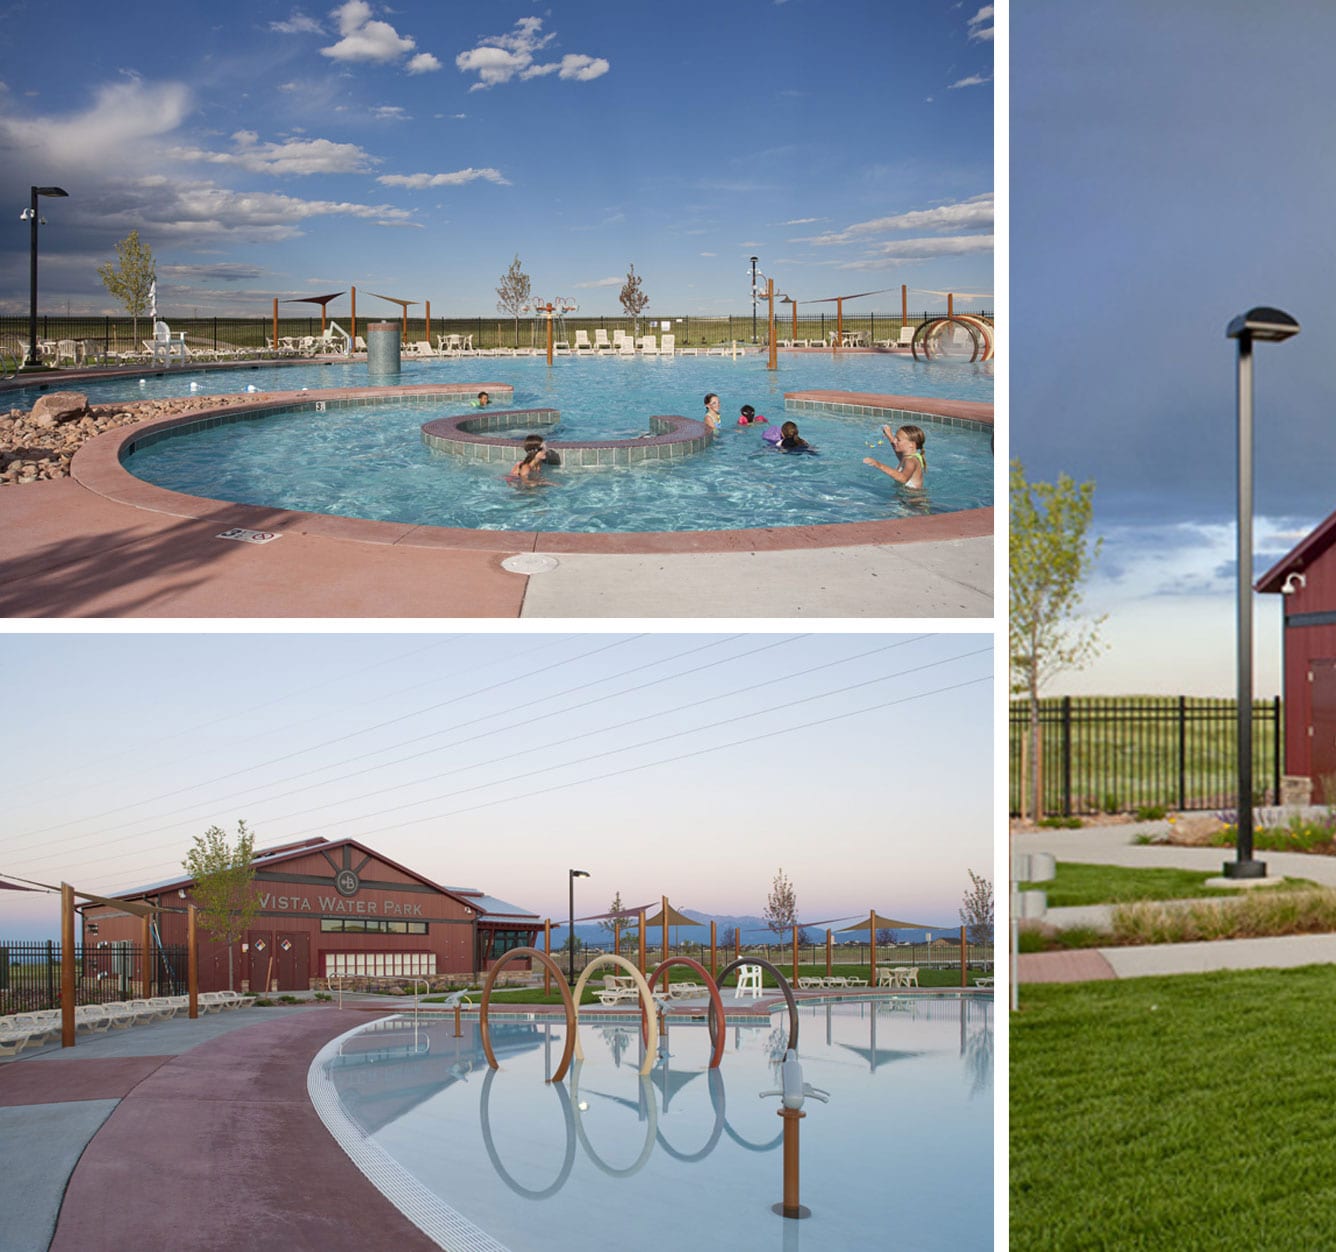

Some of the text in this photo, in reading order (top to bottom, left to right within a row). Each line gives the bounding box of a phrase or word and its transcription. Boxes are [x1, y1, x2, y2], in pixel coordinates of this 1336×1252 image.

[260, 892, 423, 916] VISTA WATER PARK
